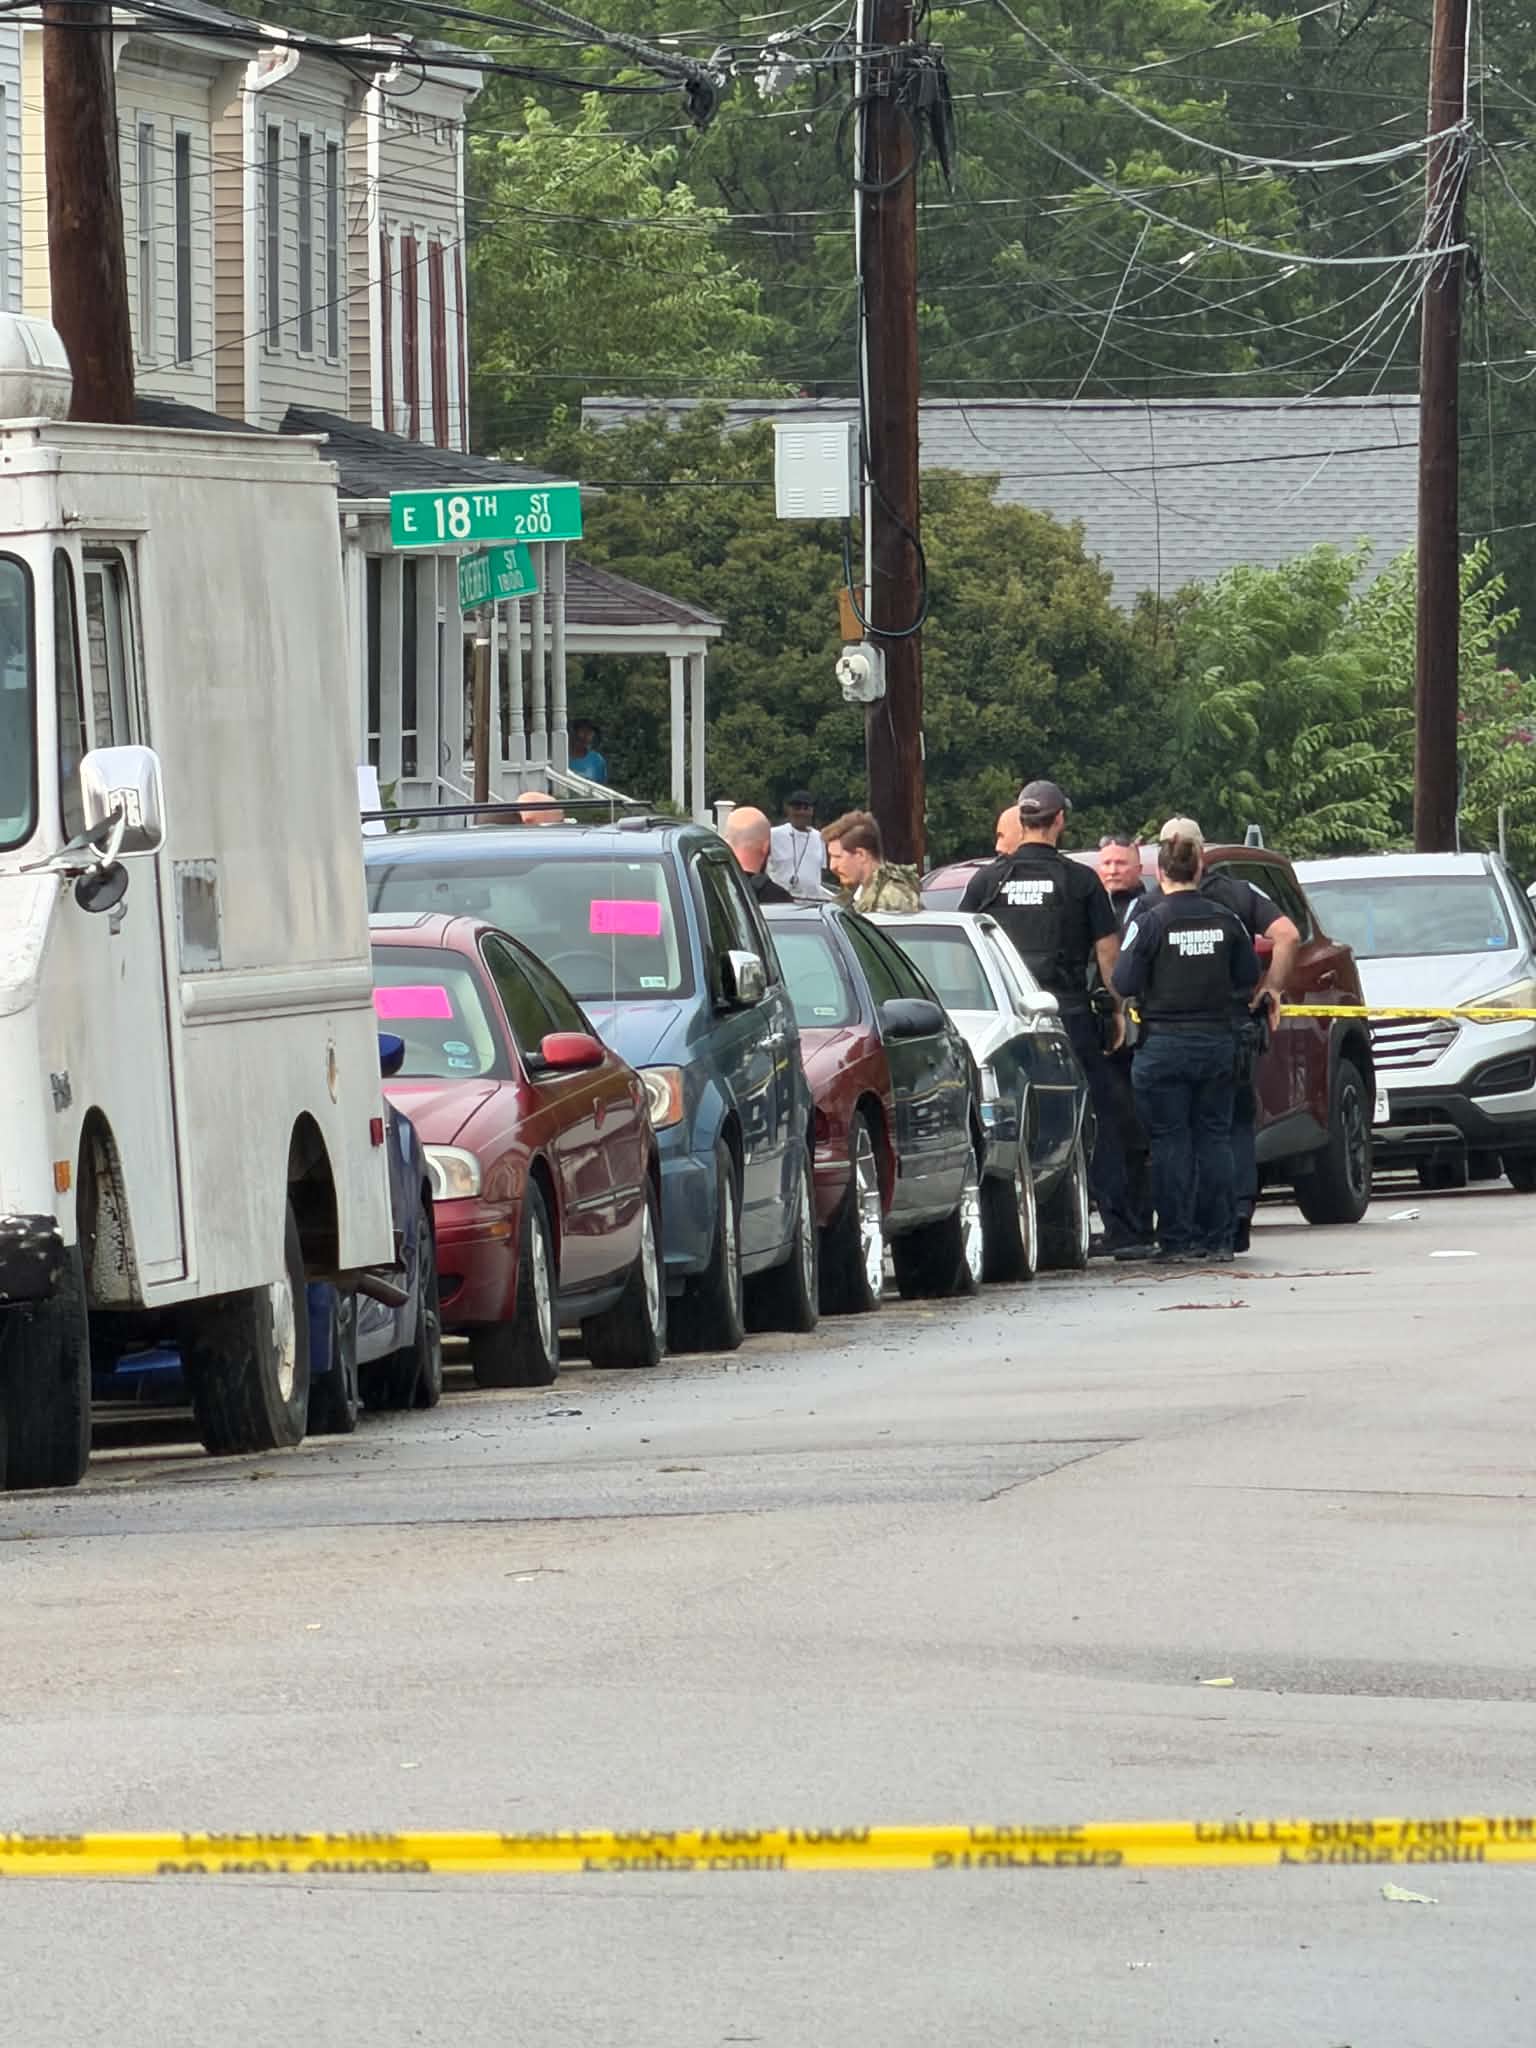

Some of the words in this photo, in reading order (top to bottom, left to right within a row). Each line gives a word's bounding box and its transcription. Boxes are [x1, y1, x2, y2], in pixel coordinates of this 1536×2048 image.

[403, 507, 417, 532] E
[434, 496, 497, 538] 18TH
[530, 493, 551, 514] ST
[514, 514, 552, 535] 200
[1007, 893, 1044, 906] POLICE
[1168, 928, 1224, 945] RICHMOND
[1179, 942, 1216, 956] POLICE
